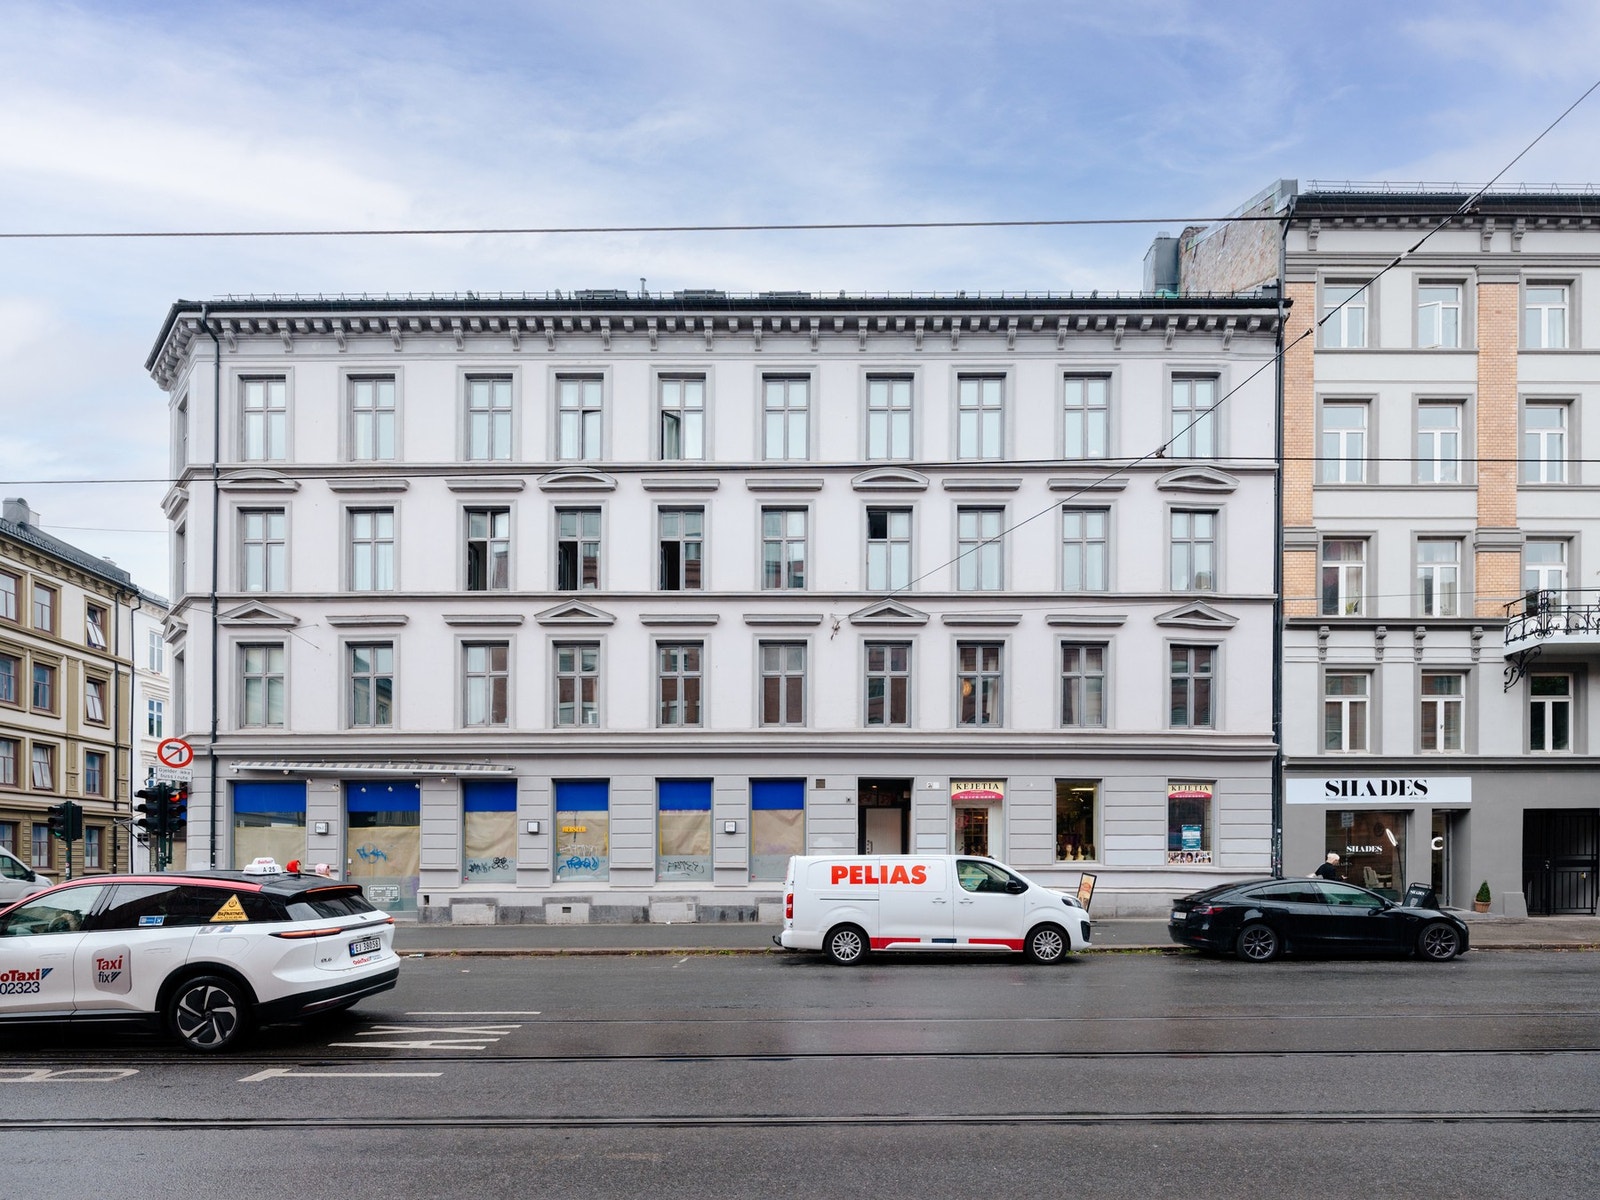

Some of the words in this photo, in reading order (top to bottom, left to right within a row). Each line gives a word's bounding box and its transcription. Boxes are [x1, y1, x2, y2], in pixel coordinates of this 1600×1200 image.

[1325, 779, 1429, 797] SHADES
[1346, 845, 1383, 853] SHADES
[831, 865, 927, 885] PELIAS
[96, 955, 123, 971] Taxi
[98, 971, 111, 984] fix
[0, 981, 40, 995] 02323
